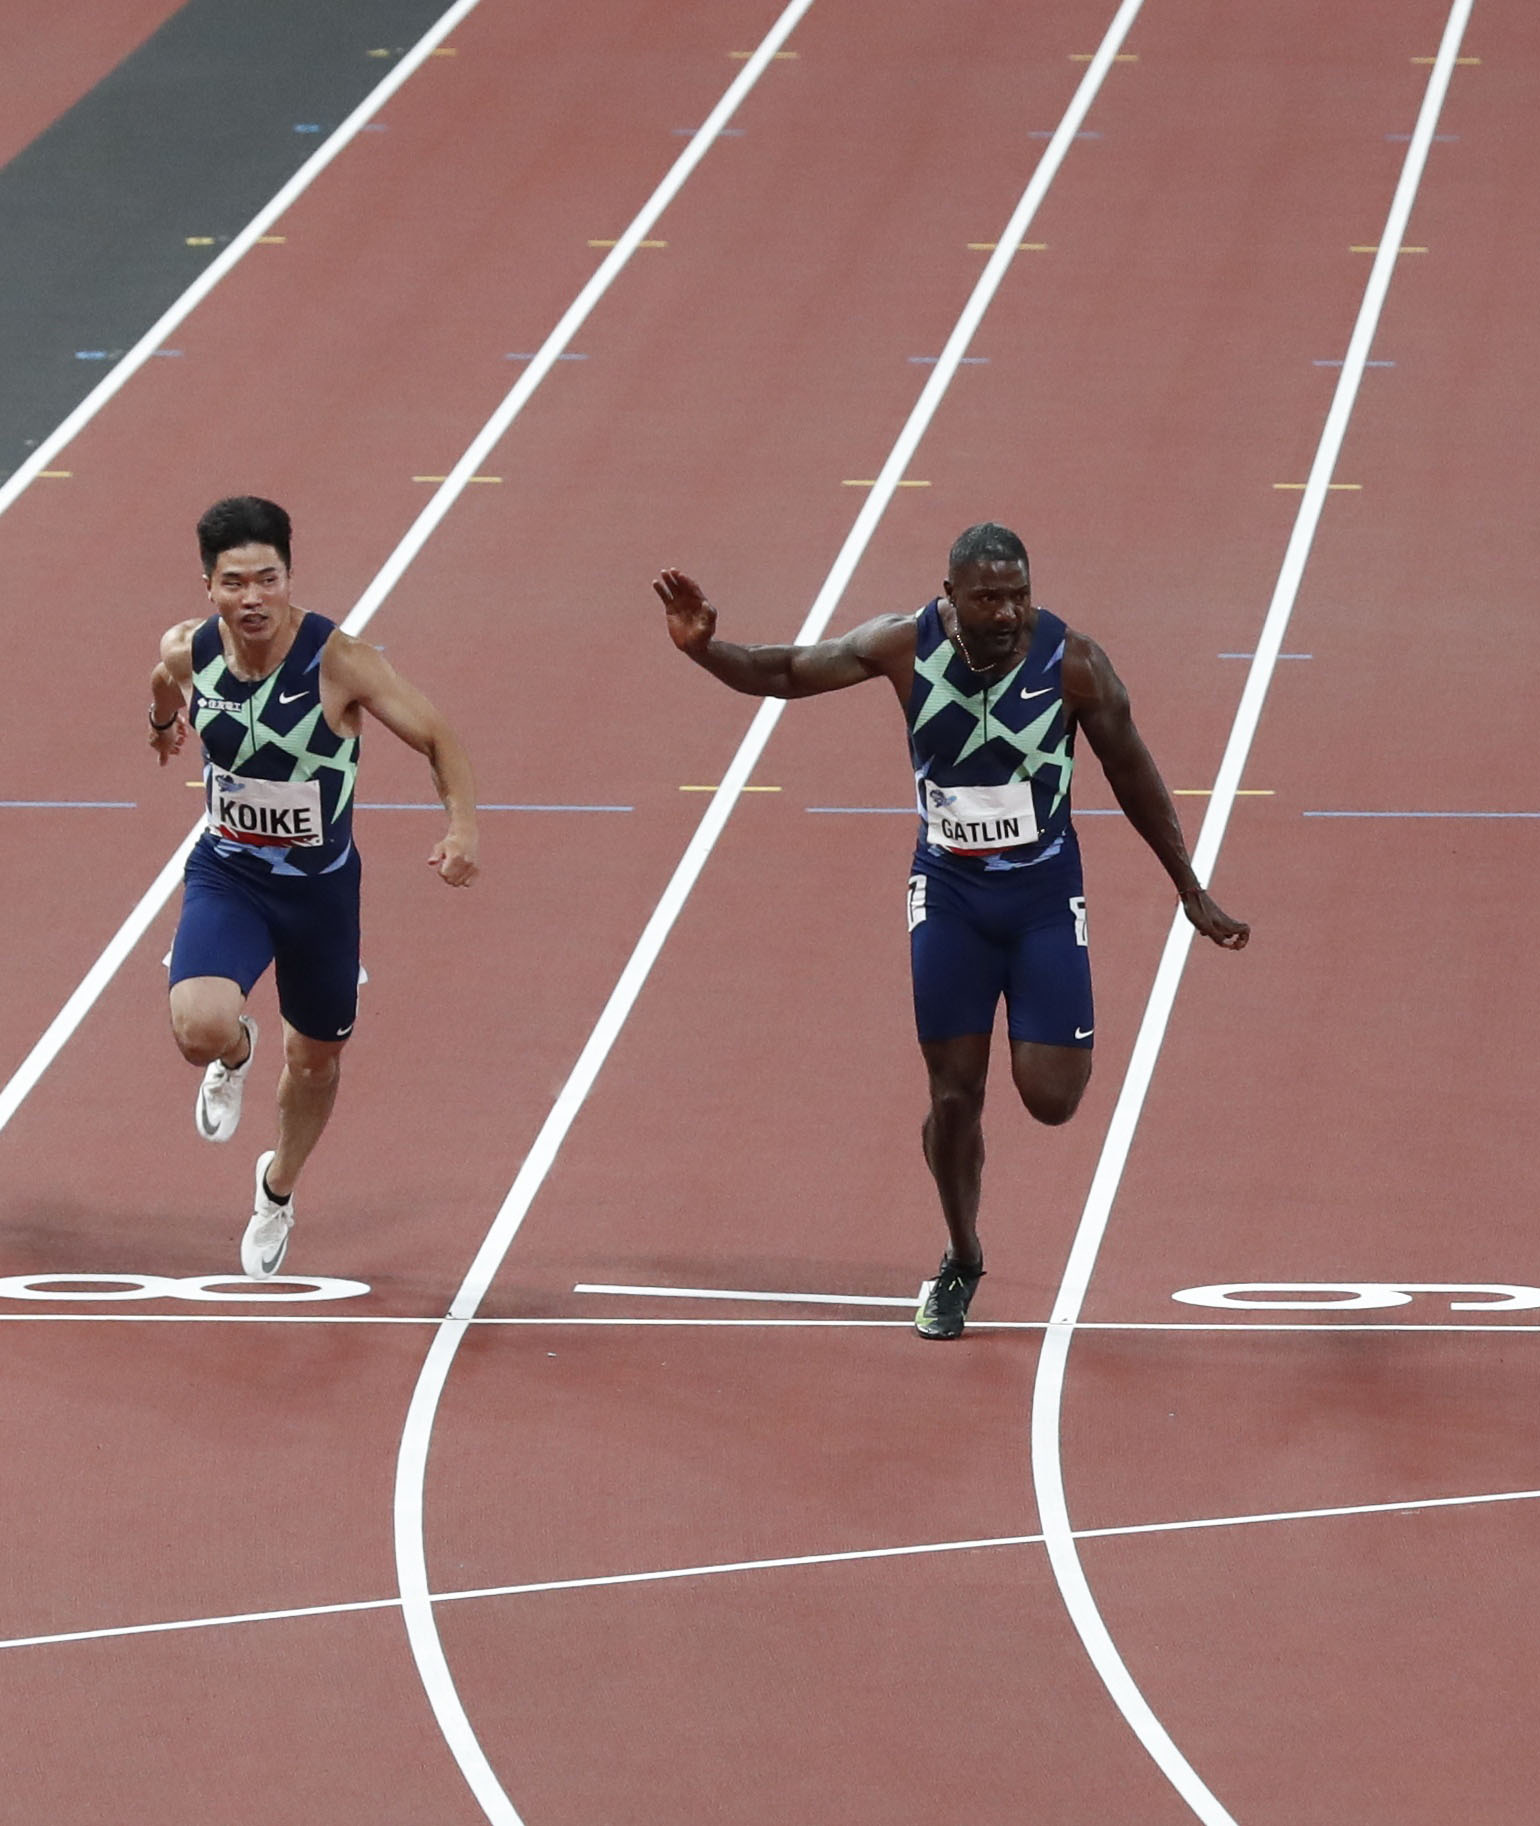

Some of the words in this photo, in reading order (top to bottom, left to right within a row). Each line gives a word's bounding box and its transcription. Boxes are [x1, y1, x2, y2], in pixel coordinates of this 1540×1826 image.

[219, 796, 313, 835] KOIKE
[941, 817, 1020, 843] GATLIN
[0, 1273, 372, 1302] 8
